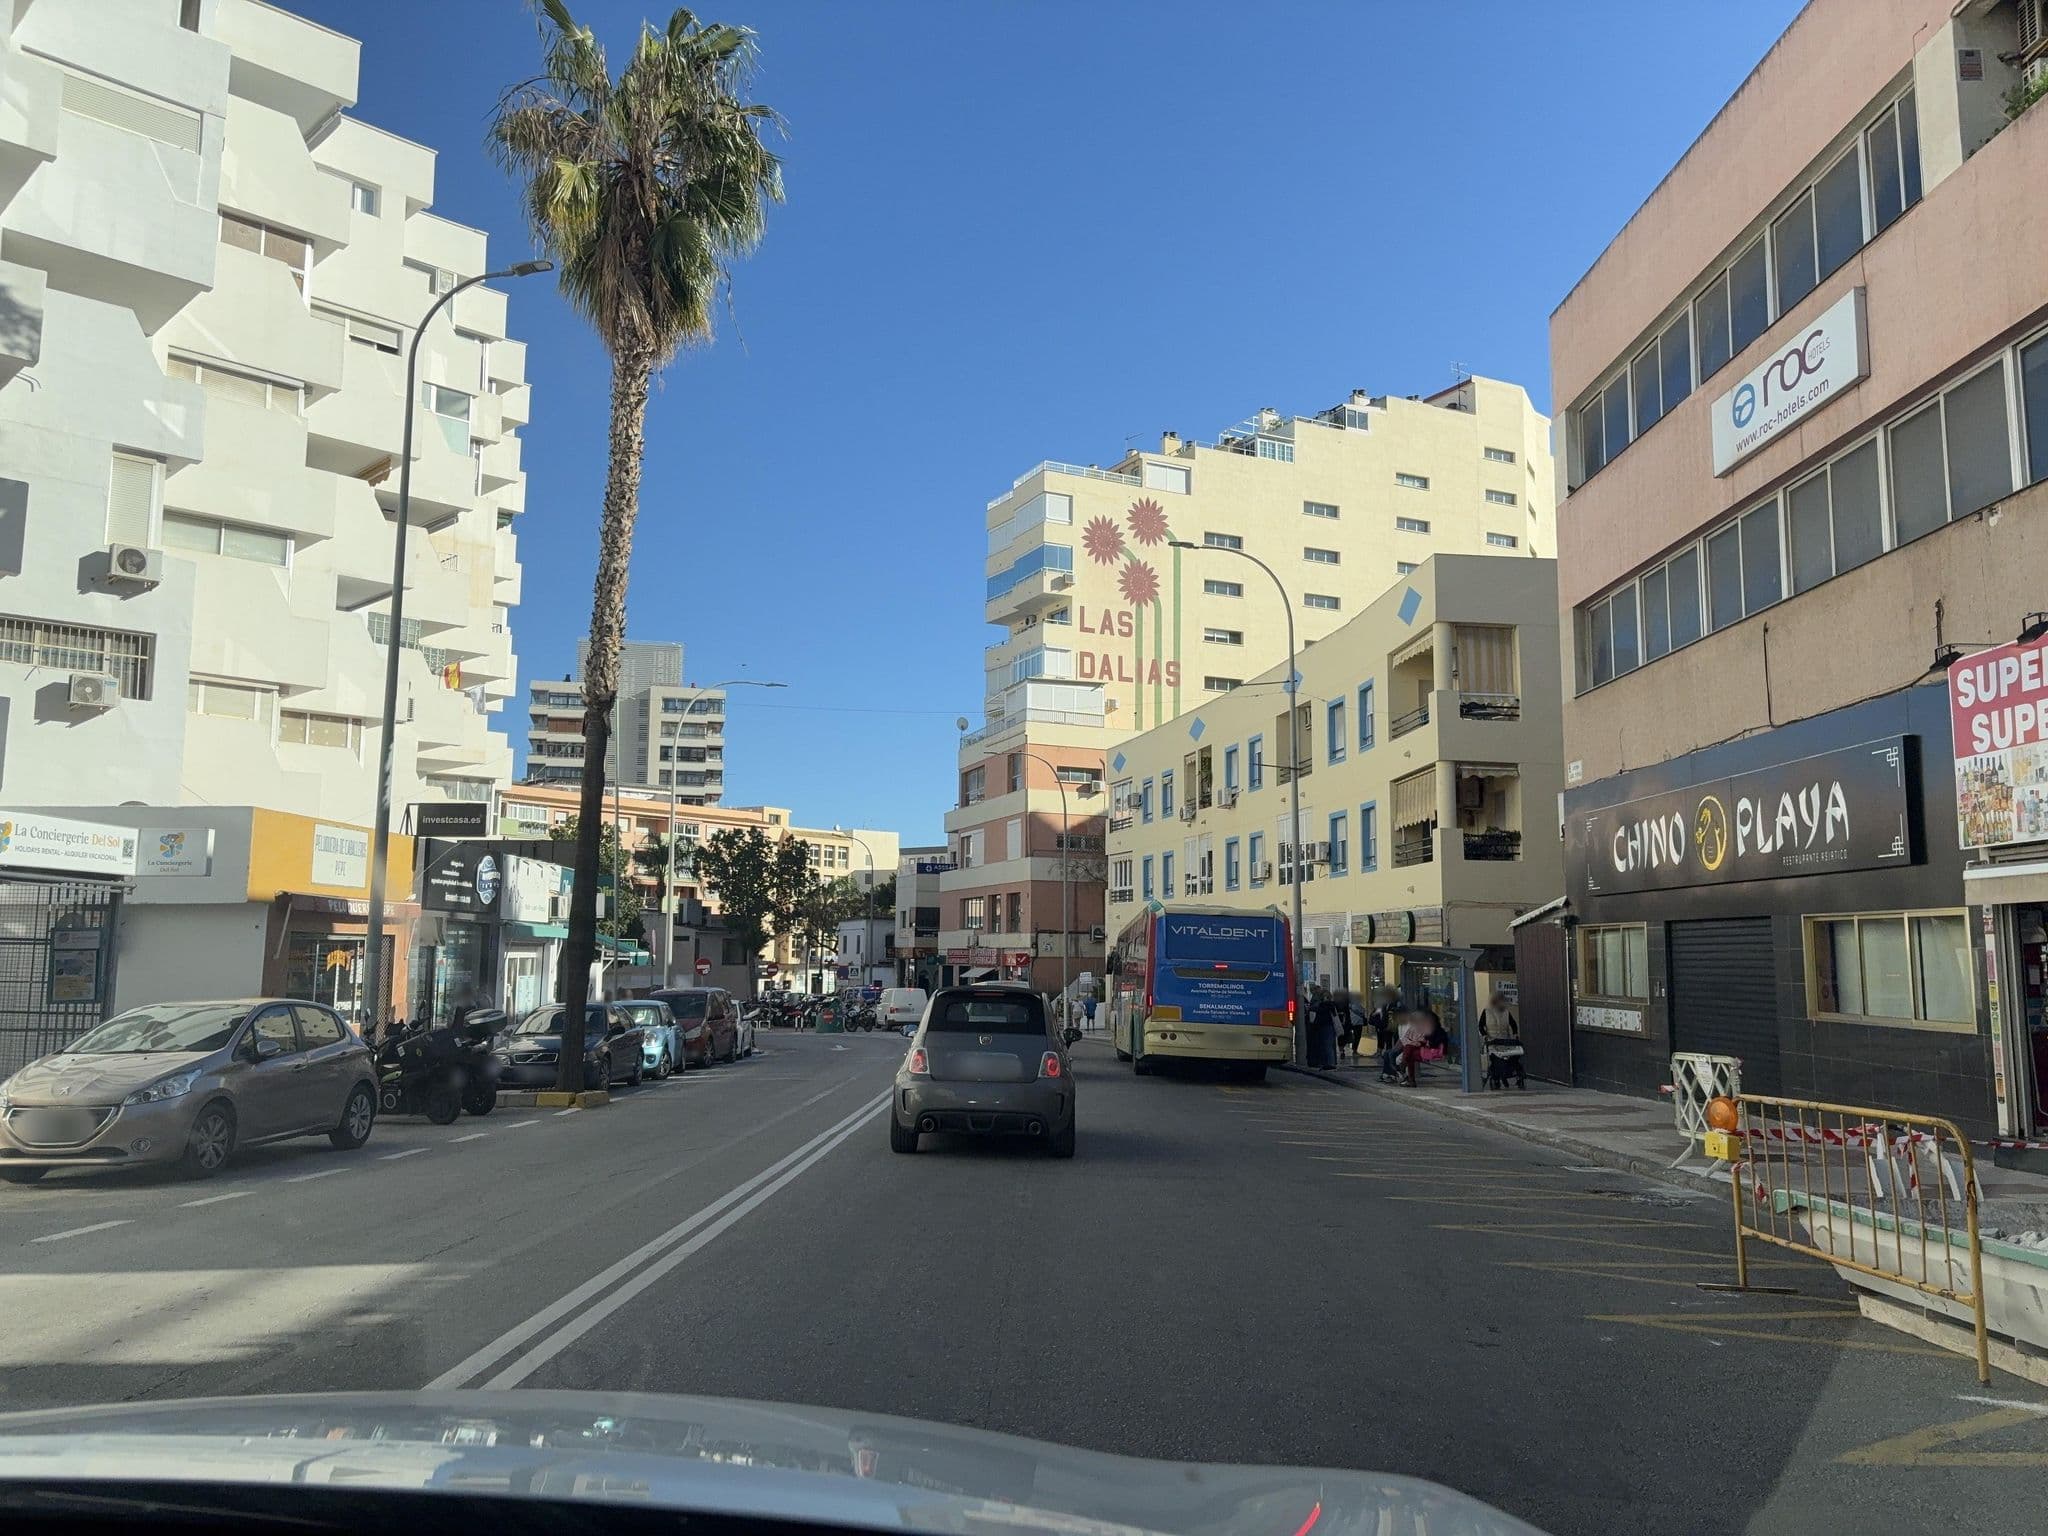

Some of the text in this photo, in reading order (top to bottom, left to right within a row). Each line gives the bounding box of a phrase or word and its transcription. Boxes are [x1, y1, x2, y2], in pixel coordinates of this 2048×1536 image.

[1807, 336, 1831, 361] HOTELS
[1762, 329, 1824, 408] roc
[1735, 378, 1830, 453] www.roc-hotels.com
[1079, 605, 1134, 638] LAS
[1078, 651, 1181, 688] DALIAS
[1956, 646, 2048, 709] SUPE
[422, 815, 481, 825] investcasa.es
[1612, 780, 1850, 873] CHINO PLAYA
[14, 823, 120, 849] La Conciergerie Del Sol
[14, 845, 41, 855] HOLIDAYS
[41, 847, 60, 857] RENTAL
[1782, 852, 1820, 866] RESTAURANTE
[1171, 925, 1269, 939] VITALDENT
[1198, 982, 1245, 991] TORREMOLINOS
